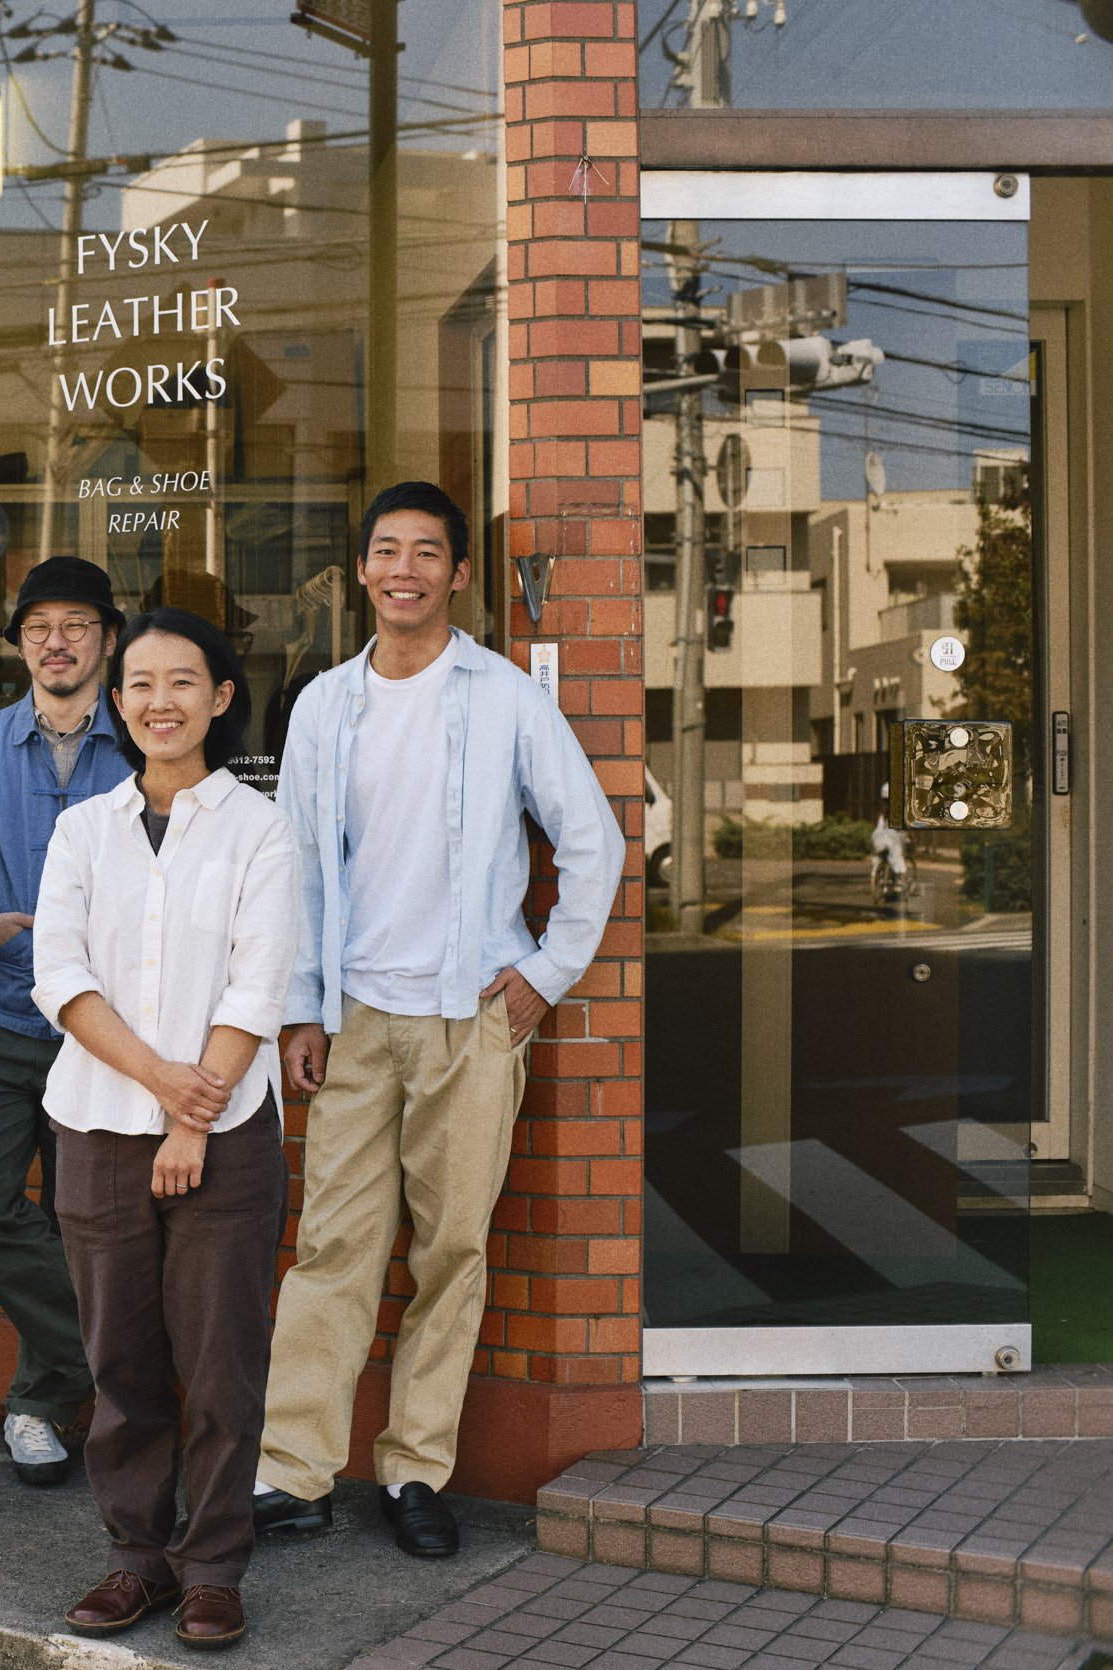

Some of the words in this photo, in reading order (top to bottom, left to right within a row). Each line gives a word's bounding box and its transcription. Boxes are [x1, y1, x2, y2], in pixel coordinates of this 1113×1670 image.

[77, 219, 209, 275] FYSKY
[48, 287, 241, 346] LEATHER
[59, 358, 227, 412] WORKS
[78, 477, 123, 499] BAG
[129, 475, 144, 496] &
[150, 470, 211, 494] SHOE
[108, 510, 181, 534] REPAIR
